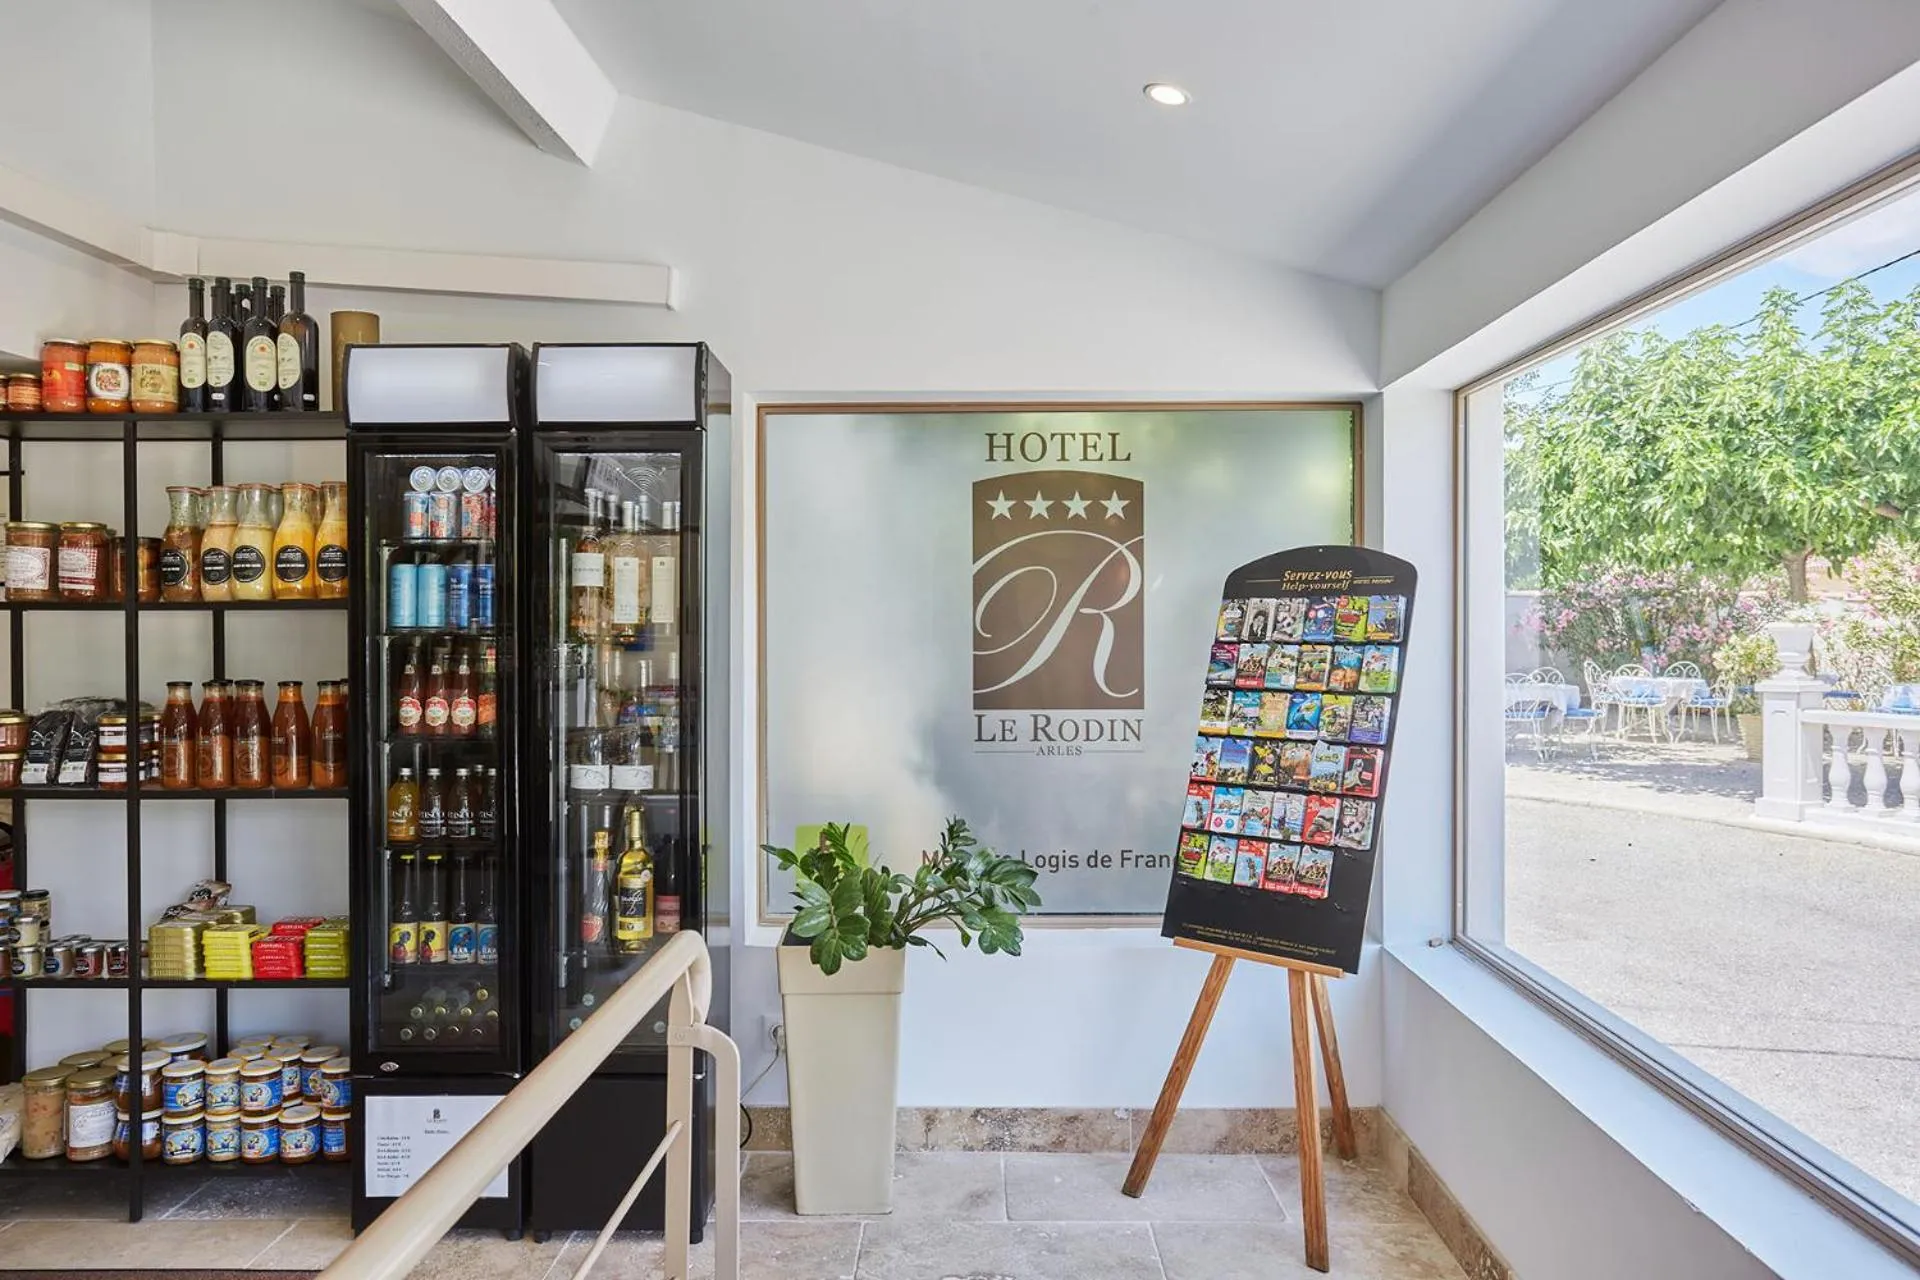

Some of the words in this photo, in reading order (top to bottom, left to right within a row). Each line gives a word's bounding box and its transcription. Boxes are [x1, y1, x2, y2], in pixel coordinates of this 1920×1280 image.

[985, 432, 1131, 462] HOTEL
[1283, 569, 1353, 582] Servez-vous
[1281, 580, 1351, 592] Help-yourself
[974, 714, 1018, 742] LE
[1030, 714, 1143, 742] RODIN
[1035, 745, 1082, 757] ARLES
[1021, 849, 1079, 873] Logis
[1086, 849, 1112, 868] de
[1121, 849, 1174, 868] Fran
